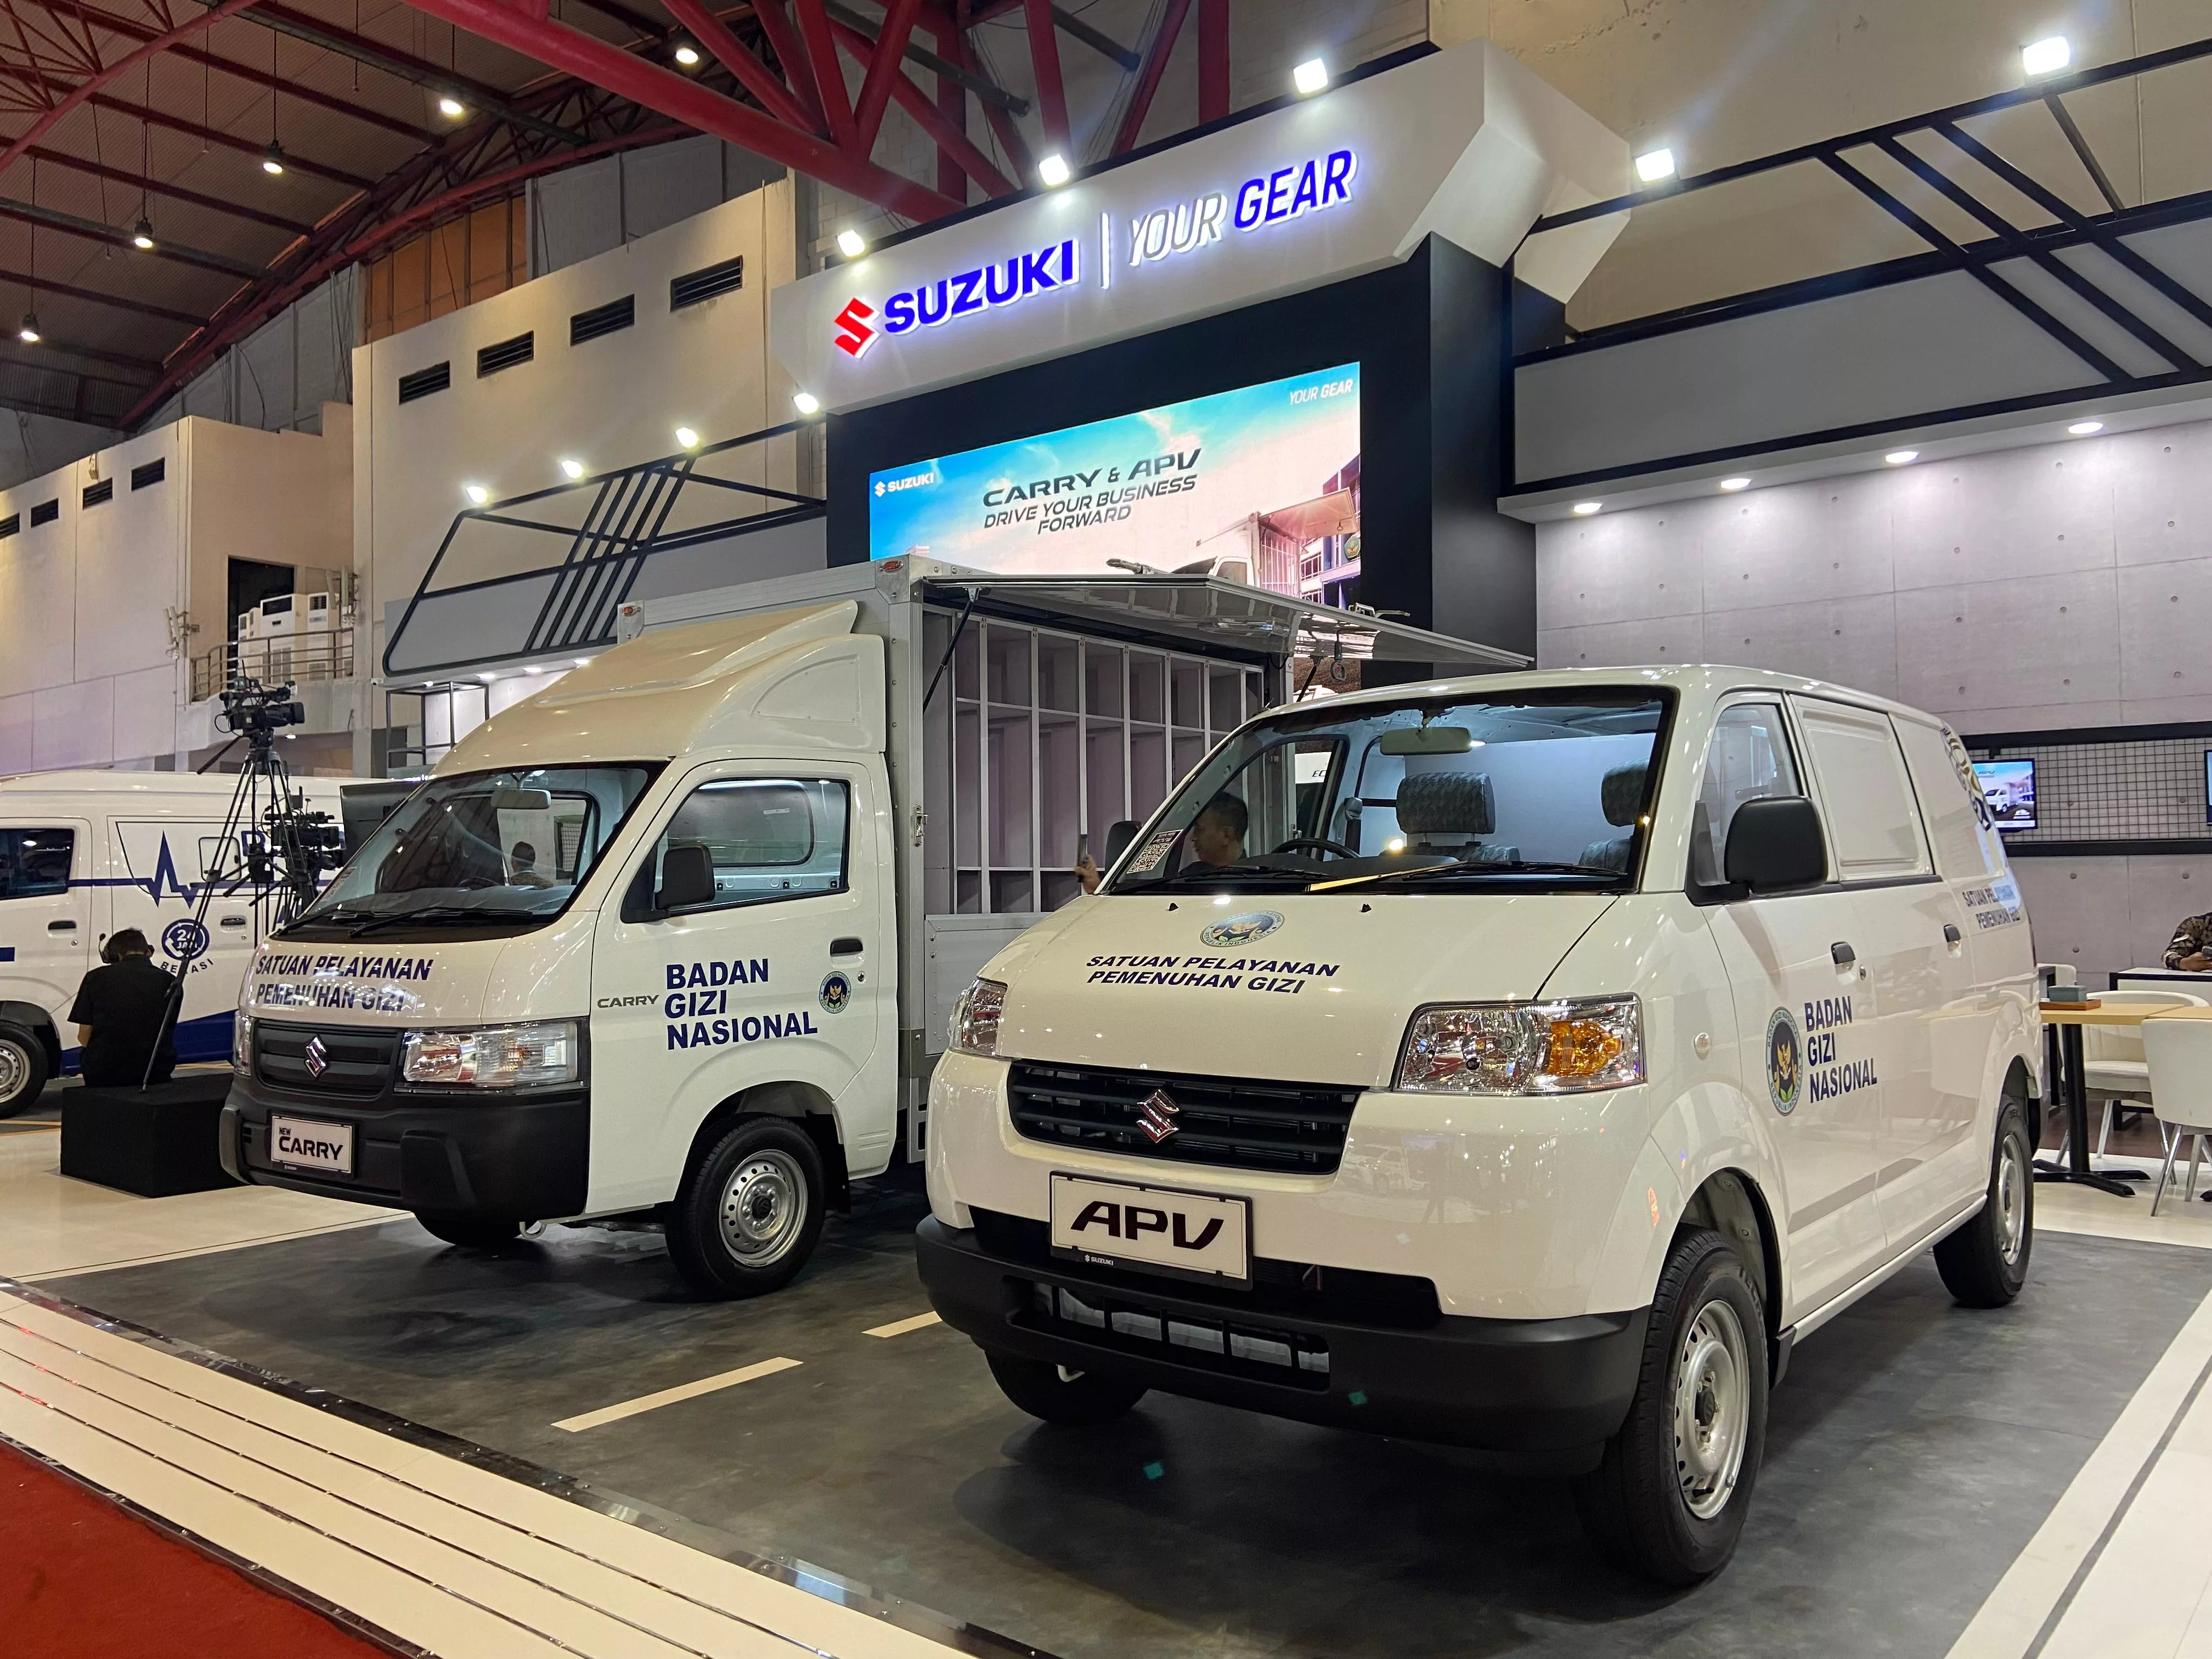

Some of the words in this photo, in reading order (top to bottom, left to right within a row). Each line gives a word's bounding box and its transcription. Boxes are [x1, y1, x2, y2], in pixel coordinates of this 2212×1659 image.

[1129, 193, 1227, 266] YOUR
[1234, 150, 1357, 232] GEAR
[885, 239, 1079, 334] SUZUKI
[1290, 386, 1317, 405] YOUR
[1321, 379, 1353, 399] GEAR
[888, 472, 934, 492] SUZUKI
[983, 468, 1103, 507] CARRY
[1108, 466, 1120, 483] &
[1127, 448, 1202, 481] APV
[984, 505, 1038, 529] DRIVE
[1043, 495, 1092, 515] YOUR
[1096, 475, 1199, 506] BUSINESS
[1037, 505, 1132, 534] FORWARD
[161, 958, 213, 974] BEASI
[256, 955, 313, 975] SATUAN
[313, 956, 434, 980] PELAYANAN
[665, 958, 769, 990] BADAN
[1086, 956, 1181, 968] SATUAN
[1182, 956, 1340, 977] PELAYANAN
[1087, 970, 1242, 989] PEMENUHAN
[1248, 977, 1306, 994] GIZI
[256, 984, 355, 1009] PEMENUHAN
[362, 988, 405, 1012] GIZI
[597, 995, 659, 1008] CARRY
[664, 990, 727, 1019] GIZI
[1804, 996, 1853, 1032] BADAN
[667, 1011, 818, 1050] NASIONAL
[1808, 1032, 1836, 1066] GIZI
[1810, 1058, 1878, 1104] NASIONAL
[279, 1136, 343, 1160] CARRY
[1070, 1200, 1224, 1250] APV
[1091, 1256, 1114, 1266] SUZUKI
